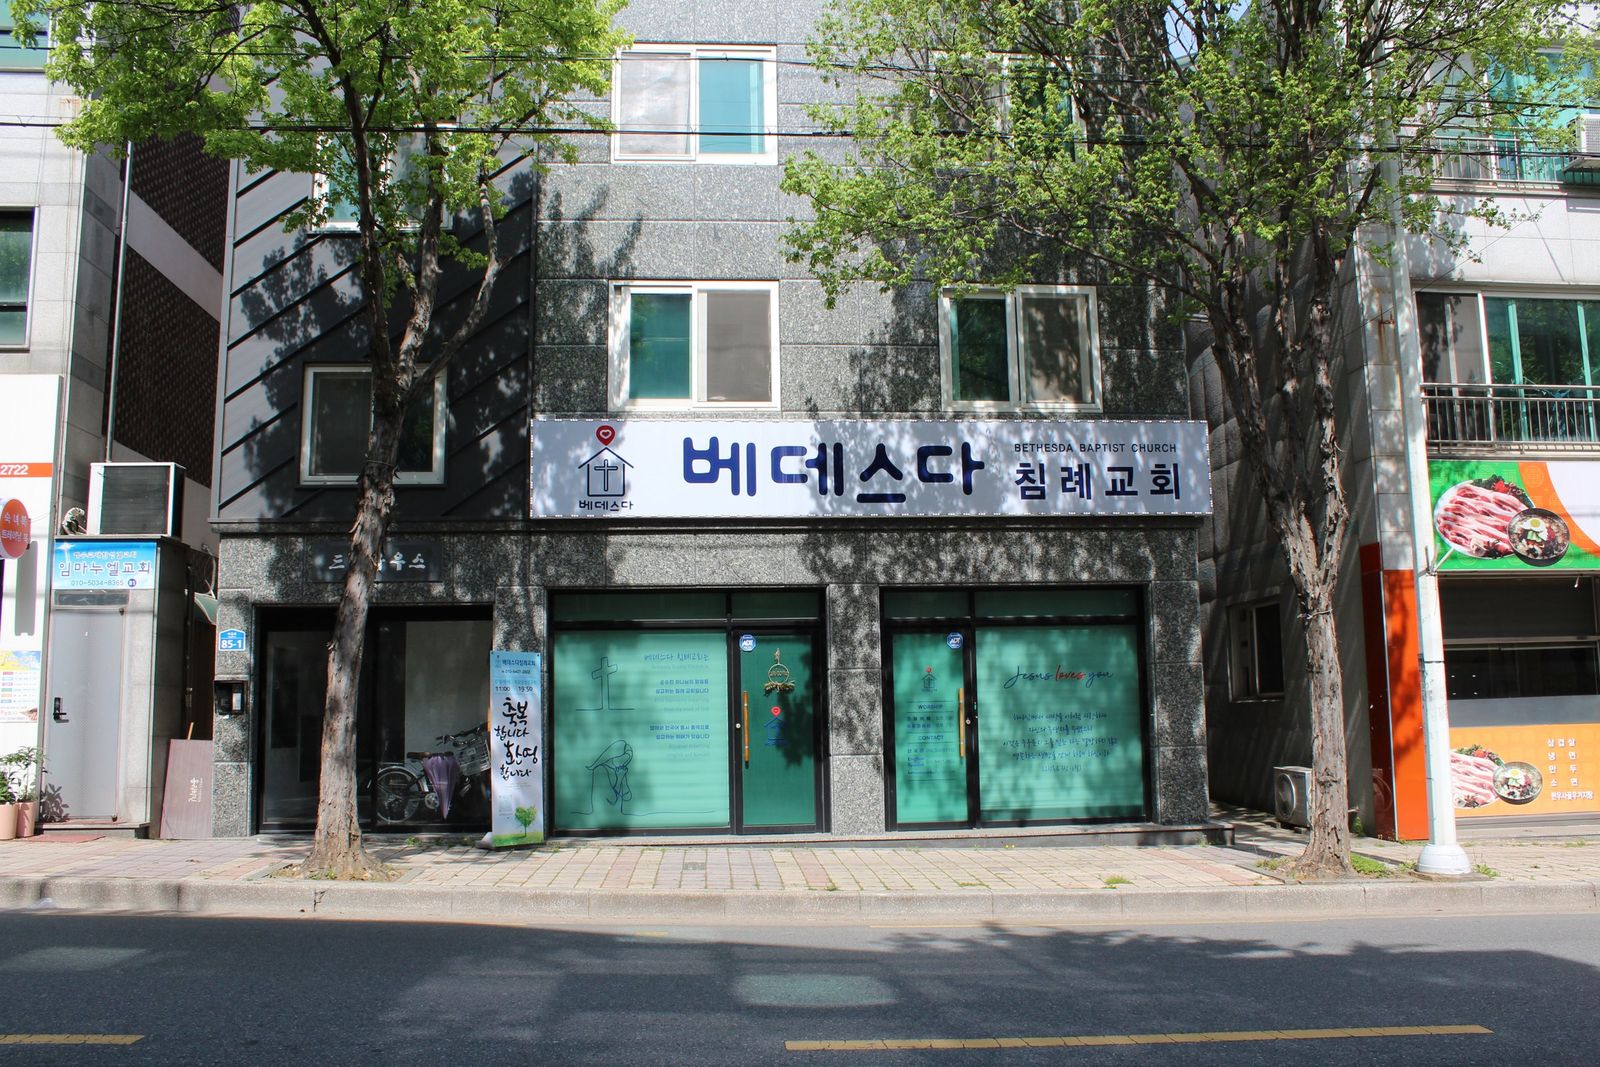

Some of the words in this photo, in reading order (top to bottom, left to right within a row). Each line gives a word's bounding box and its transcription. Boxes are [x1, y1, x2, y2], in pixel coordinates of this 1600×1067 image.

[1014, 443, 1073, 453] BETHESDA
[1079, 443, 1126, 453] BAPTIST
[1131, 443, 1177, 453] CHURCH
[0, 464, 28, 476] 2722
[683, 436, 985, 503] 베데스다
[1015, 463, 1180, 500] 침례교회
[578, 500, 634, 512] 베데스다
[60, 561, 150, 576] 임마누엘교회
[222, 640, 242, 648] 85-1
[1004, 665, 1053, 689] Jesus
[1056, 664, 1084, 680] loves
[1086, 670, 1114, 688] you
[494, 725, 530, 741] 합니다
[504, 741, 539, 766] 환영
[500, 764, 532, 781] 합니다
